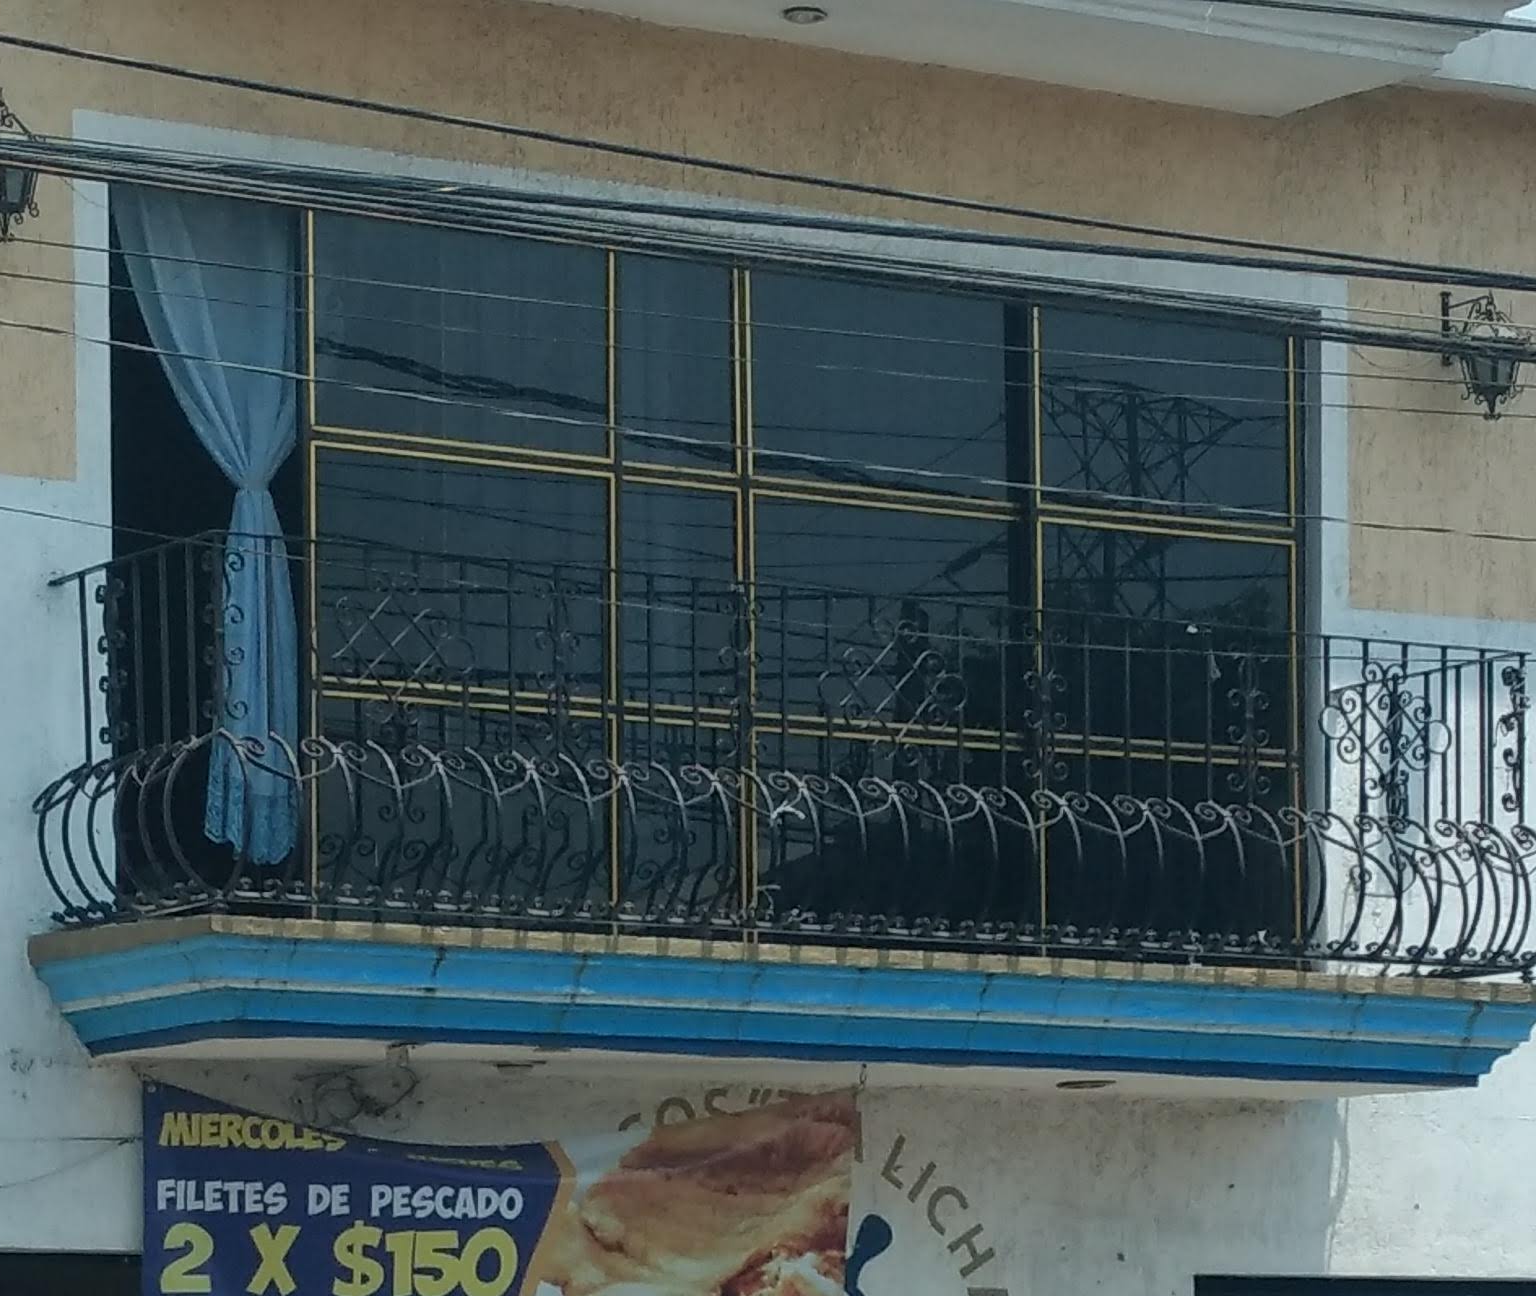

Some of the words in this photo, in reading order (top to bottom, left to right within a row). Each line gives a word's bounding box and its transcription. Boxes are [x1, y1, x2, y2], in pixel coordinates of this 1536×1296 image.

[156, 1179, 287, 1215] FILETES
[307, 1183, 350, 1216] DE
[370, 1185, 524, 1220] PESCADO
[160, 1222, 214, 1294] 2
[245, 1222, 301, 1296] X
